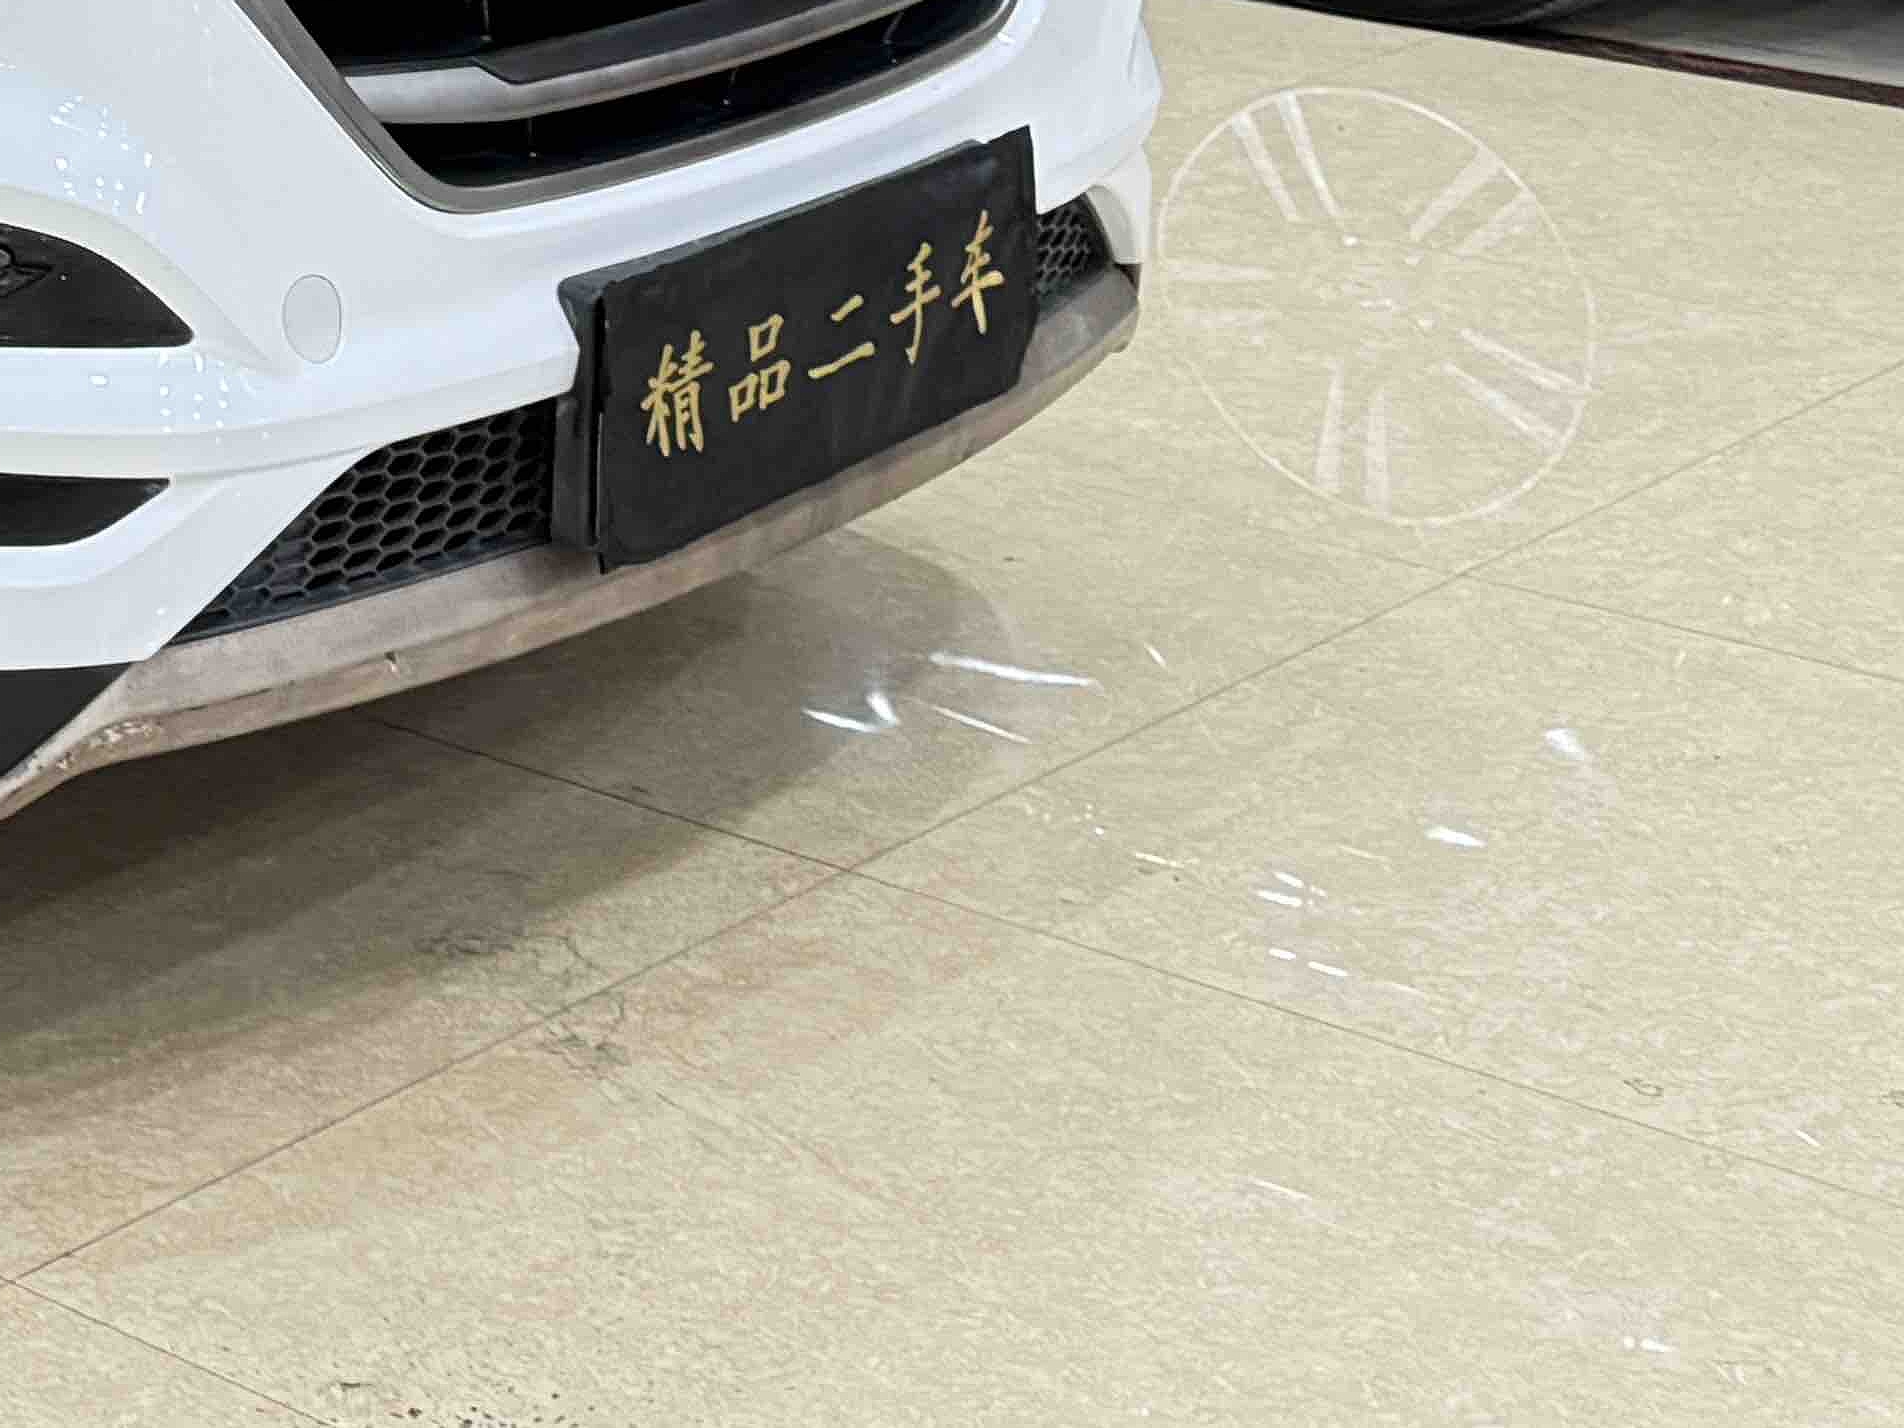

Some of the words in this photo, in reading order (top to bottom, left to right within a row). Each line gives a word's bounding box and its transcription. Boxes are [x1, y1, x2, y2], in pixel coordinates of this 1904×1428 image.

[640, 209, 1004, 456] 精品二手车
